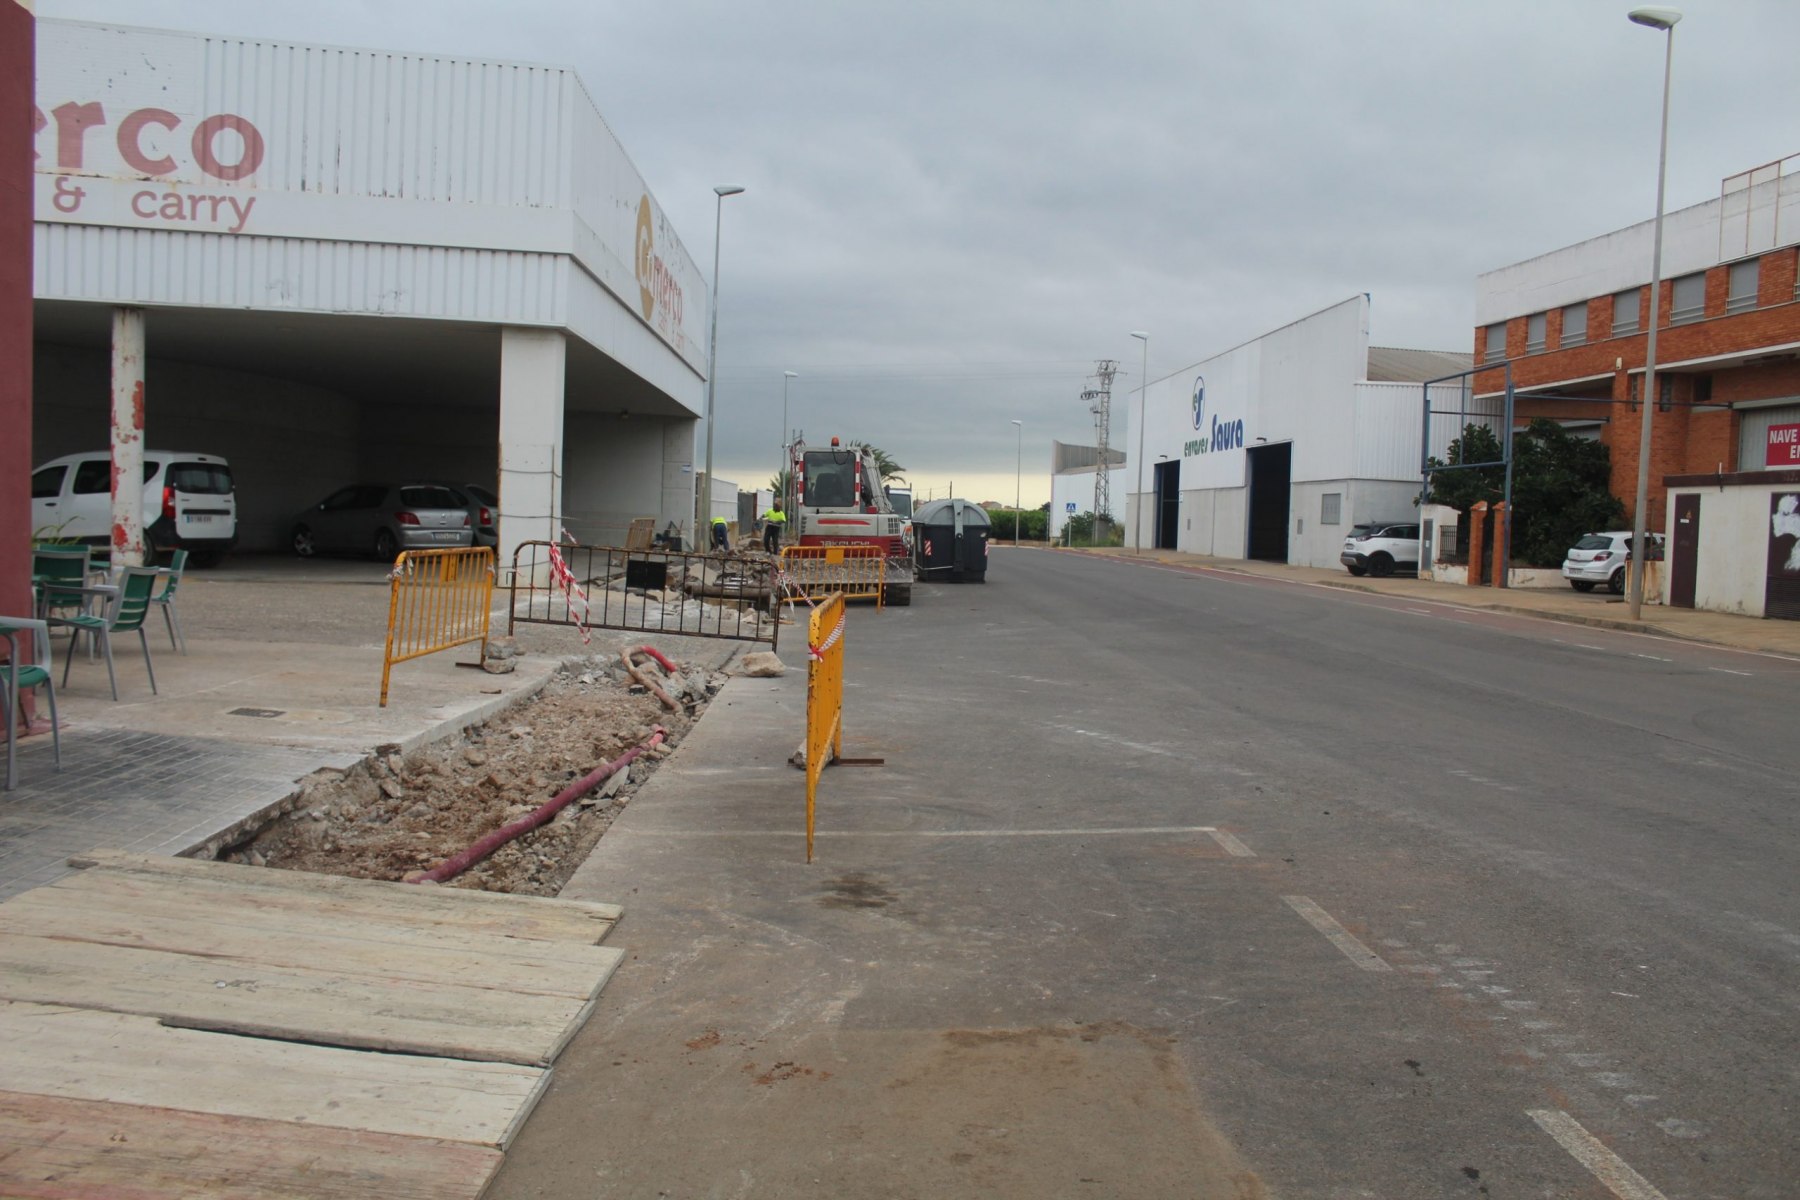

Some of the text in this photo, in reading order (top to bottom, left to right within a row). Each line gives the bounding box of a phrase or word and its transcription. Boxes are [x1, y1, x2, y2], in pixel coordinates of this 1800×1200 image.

[53, 177, 256, 233] & carry
[1211, 414, 1243, 452] Saura
[1769, 429, 1798, 443] NAVE
